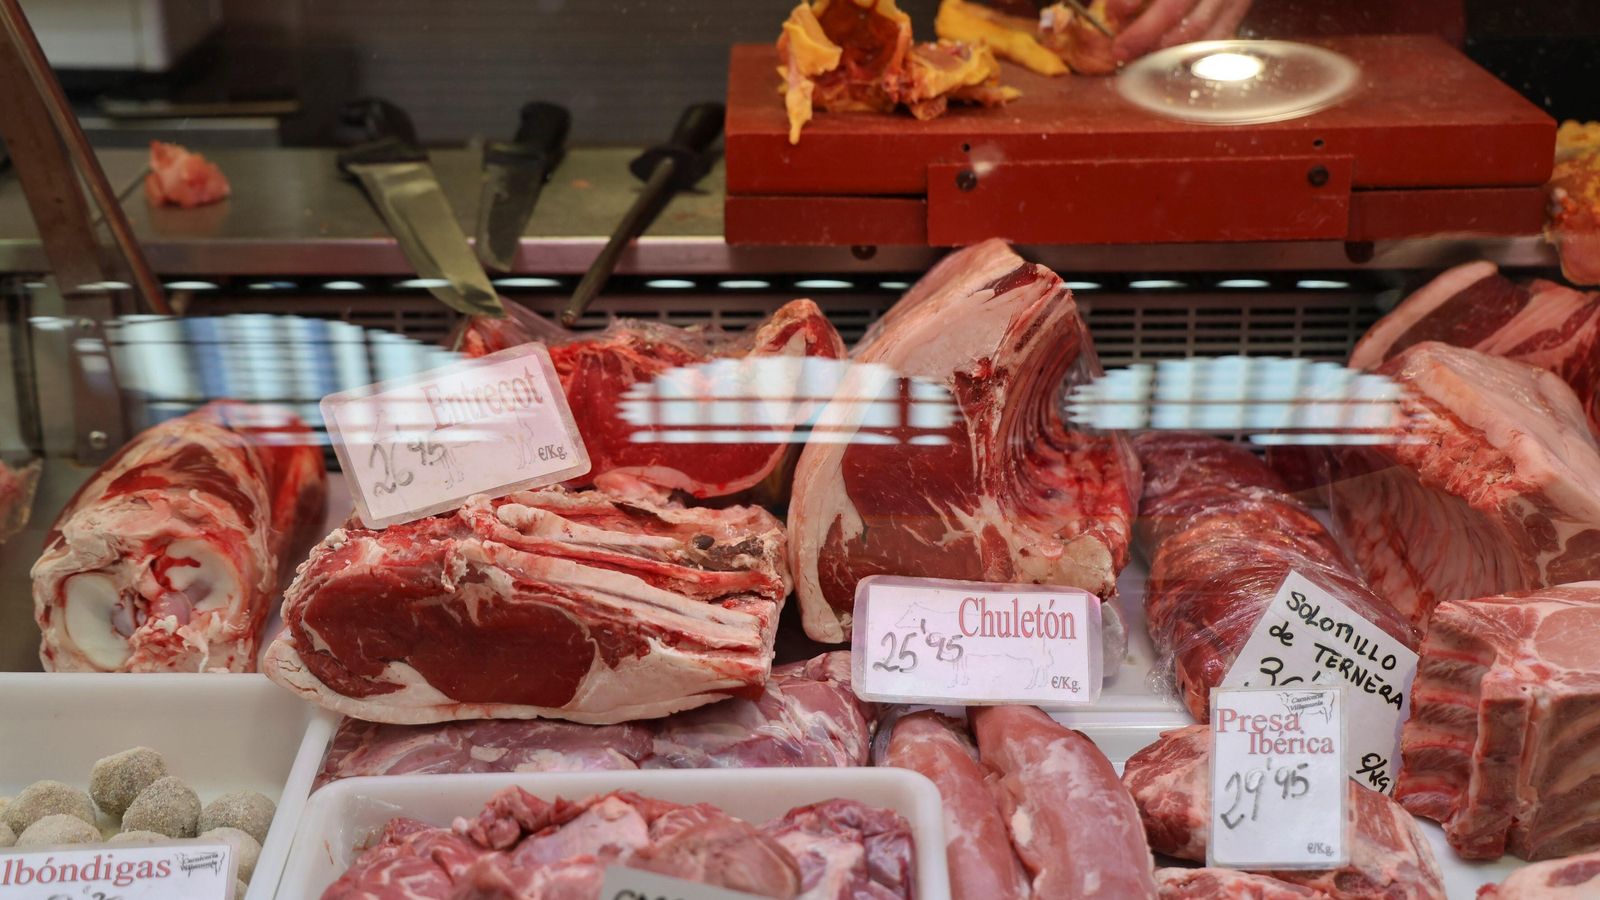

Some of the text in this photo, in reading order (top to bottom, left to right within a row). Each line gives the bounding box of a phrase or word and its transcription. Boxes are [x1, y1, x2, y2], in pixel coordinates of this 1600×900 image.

[420, 366, 544, 430] Entrecot
[958, 597, 1077, 640] Chuletón
[1269, 621, 1294, 646] de
[1051, 675, 1081, 693] €/Kg.
[1216, 708, 1301, 732] Presa
[1248, 730, 1335, 754] Ibérica
[1, 854, 171, 887] lbóndigas
